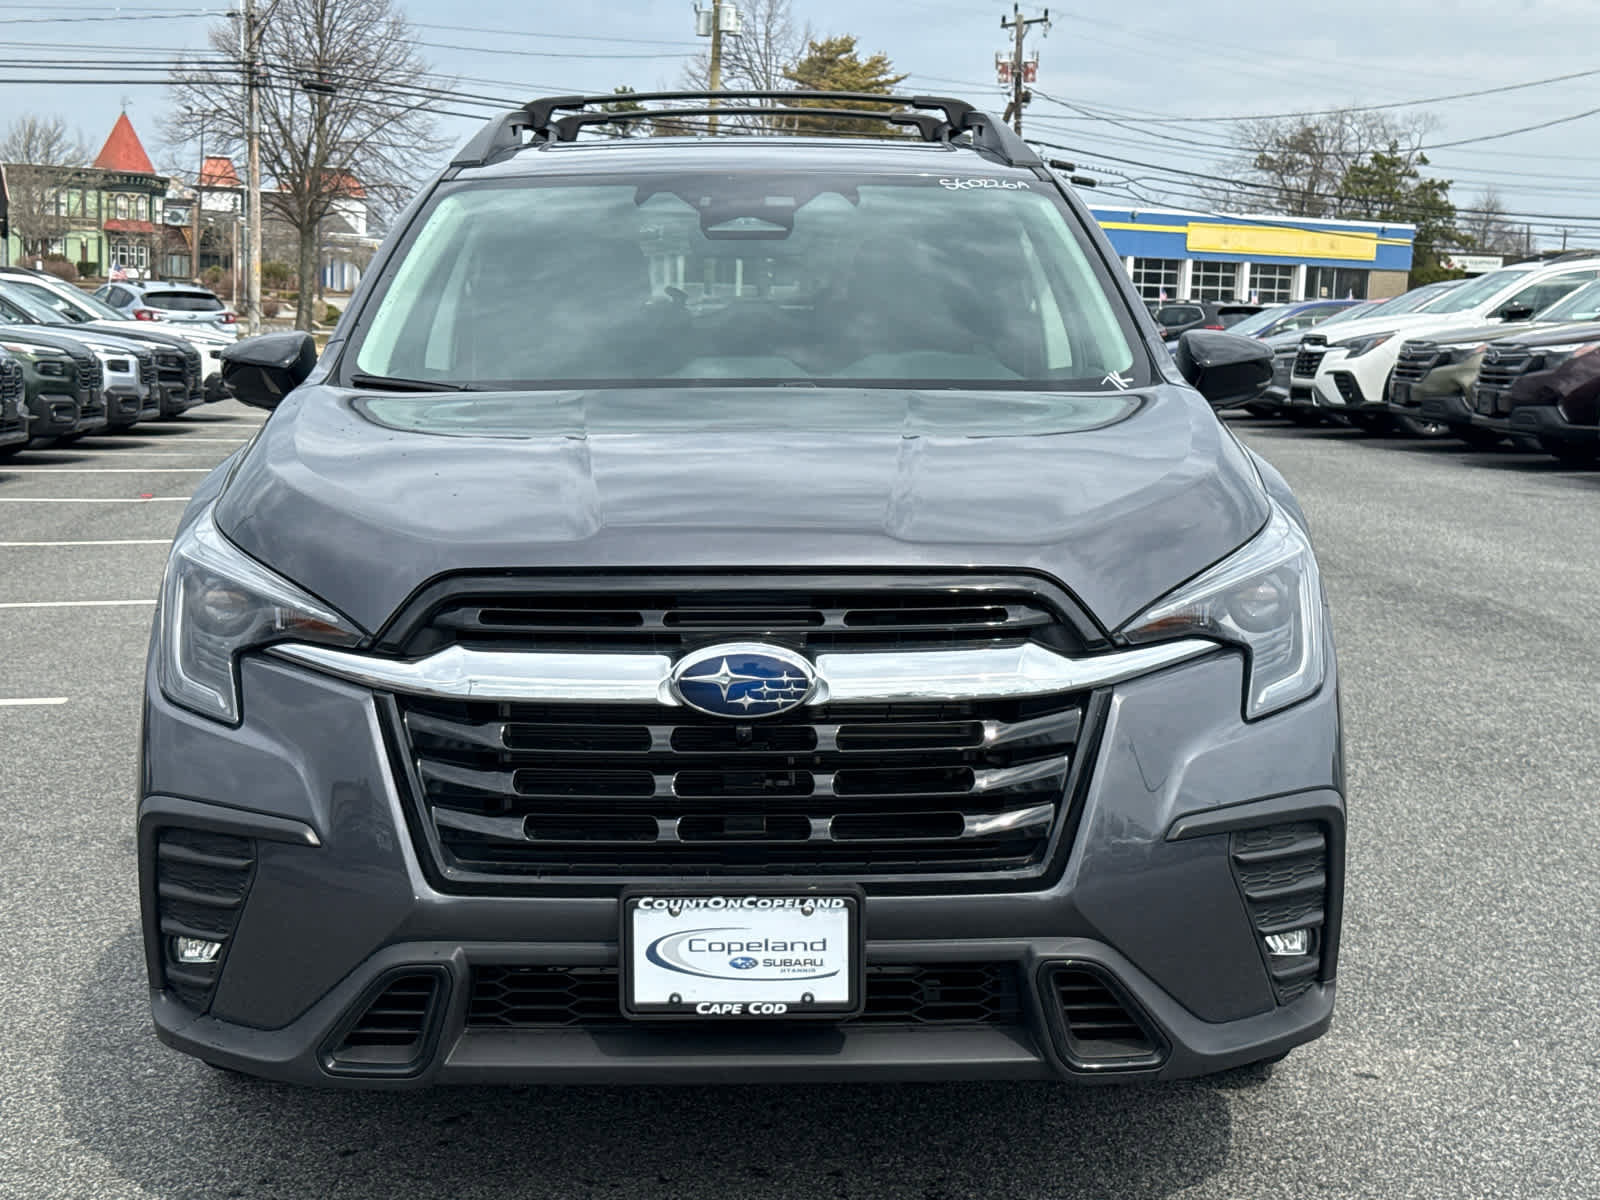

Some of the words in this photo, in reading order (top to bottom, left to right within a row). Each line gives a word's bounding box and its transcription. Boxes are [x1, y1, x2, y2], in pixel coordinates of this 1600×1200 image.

[688, 938, 826, 955] Copeland
[762, 958, 824, 967] SUBARU
[696, 1002, 743, 1014] CAPE
[748, 1002, 787, 1014] COD
